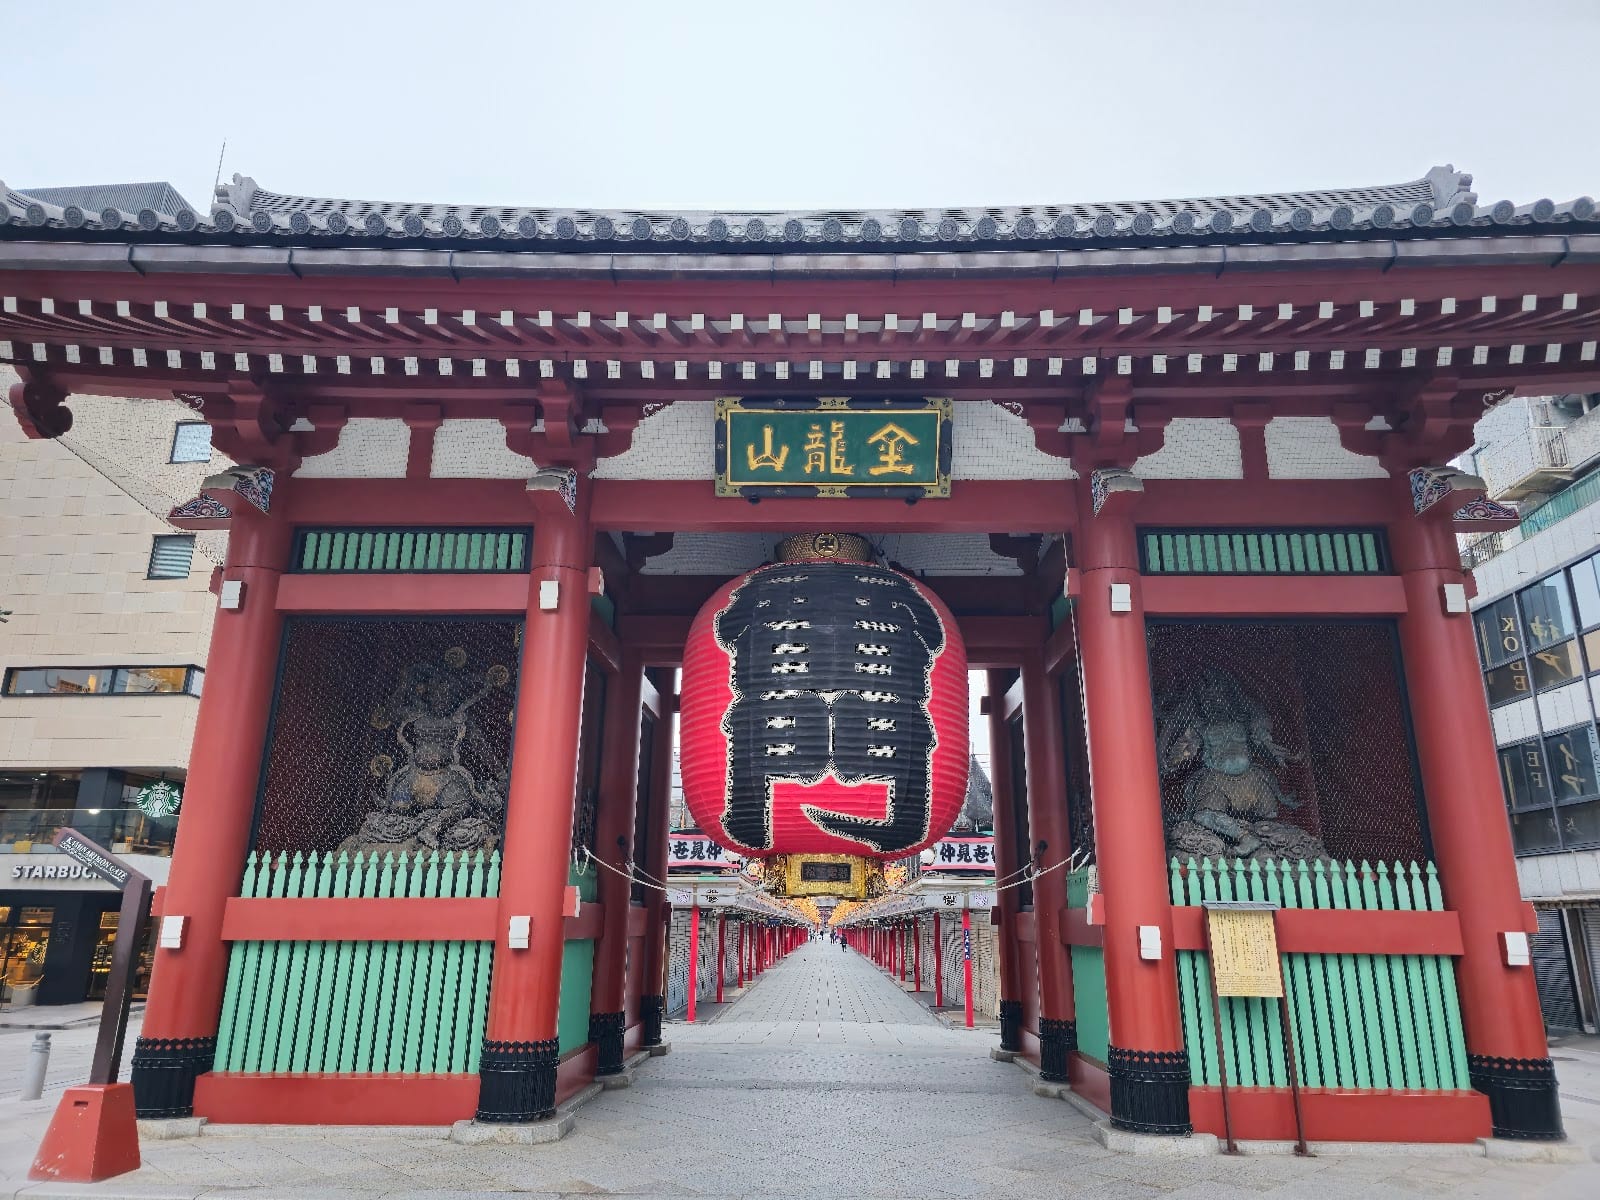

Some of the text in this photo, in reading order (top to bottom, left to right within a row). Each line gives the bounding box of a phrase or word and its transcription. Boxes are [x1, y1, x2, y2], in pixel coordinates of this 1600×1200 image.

[746, 419, 920, 476] 金龍山
[668, 840, 722, 860] 仲見世
[939, 842, 996, 863] 仲見世
[11, 864, 102, 879] STARBUC
